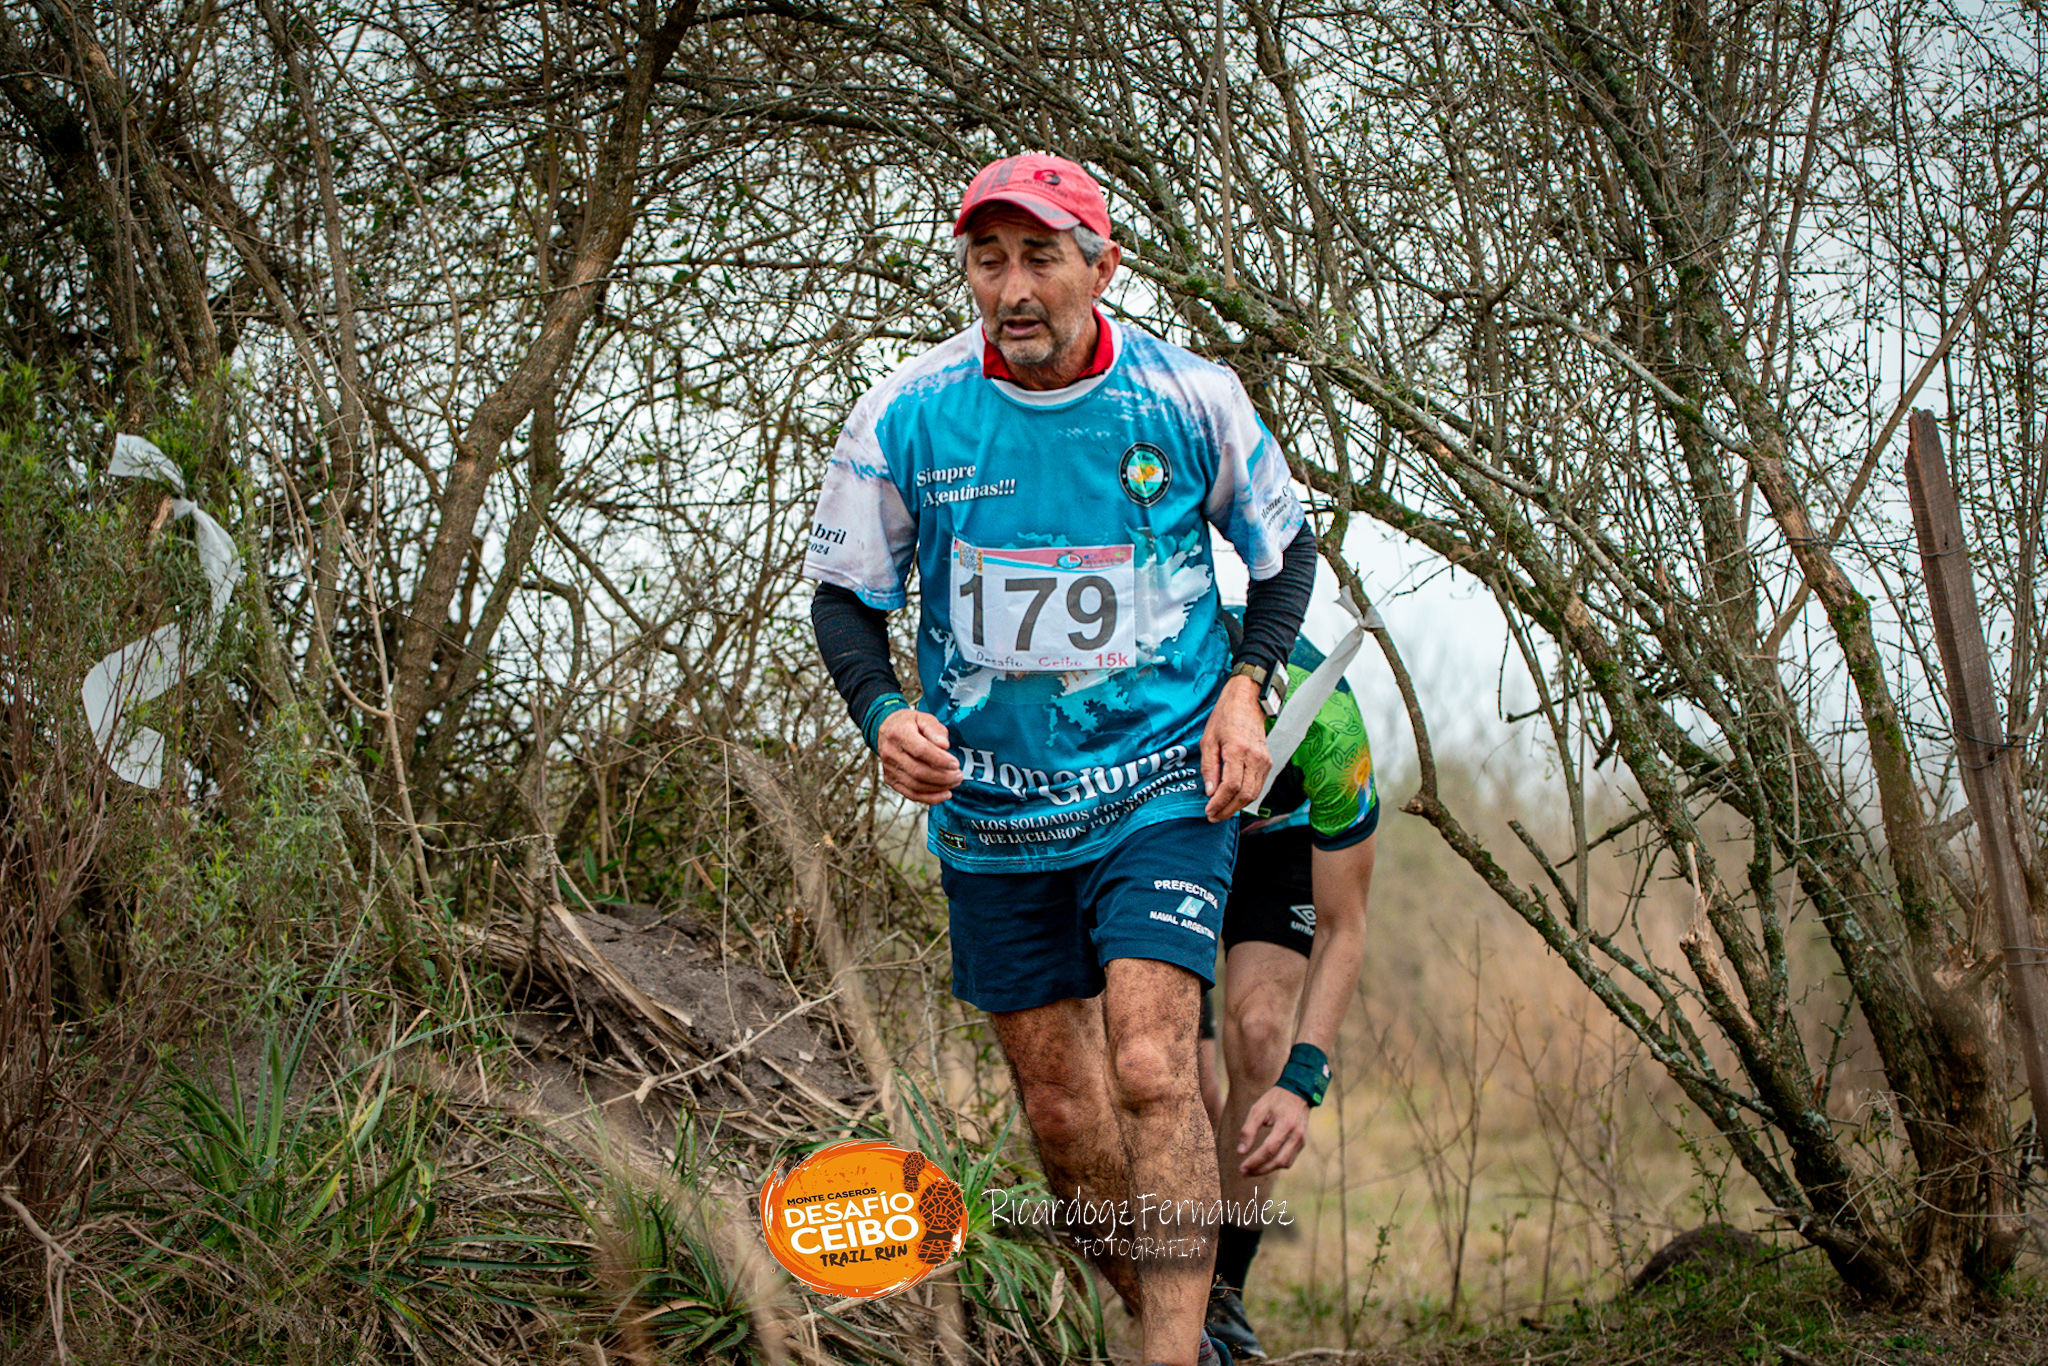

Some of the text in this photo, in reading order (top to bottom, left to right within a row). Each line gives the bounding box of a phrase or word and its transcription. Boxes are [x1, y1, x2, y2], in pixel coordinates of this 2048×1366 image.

[809, 522, 847, 545] bril
[808, 541, 831, 555] 024
[959, 573, 1119, 652] 179
[1095, 653, 1130, 667] 15k
[1010, 808, 1090, 831] SOLDADOS
[978, 833, 1007, 846] QUE
[1153, 879, 1219, 910] PREFECTURA
[1149, 910, 1179, 926] NAVAL
[1290, 920, 1316, 937] umbr
